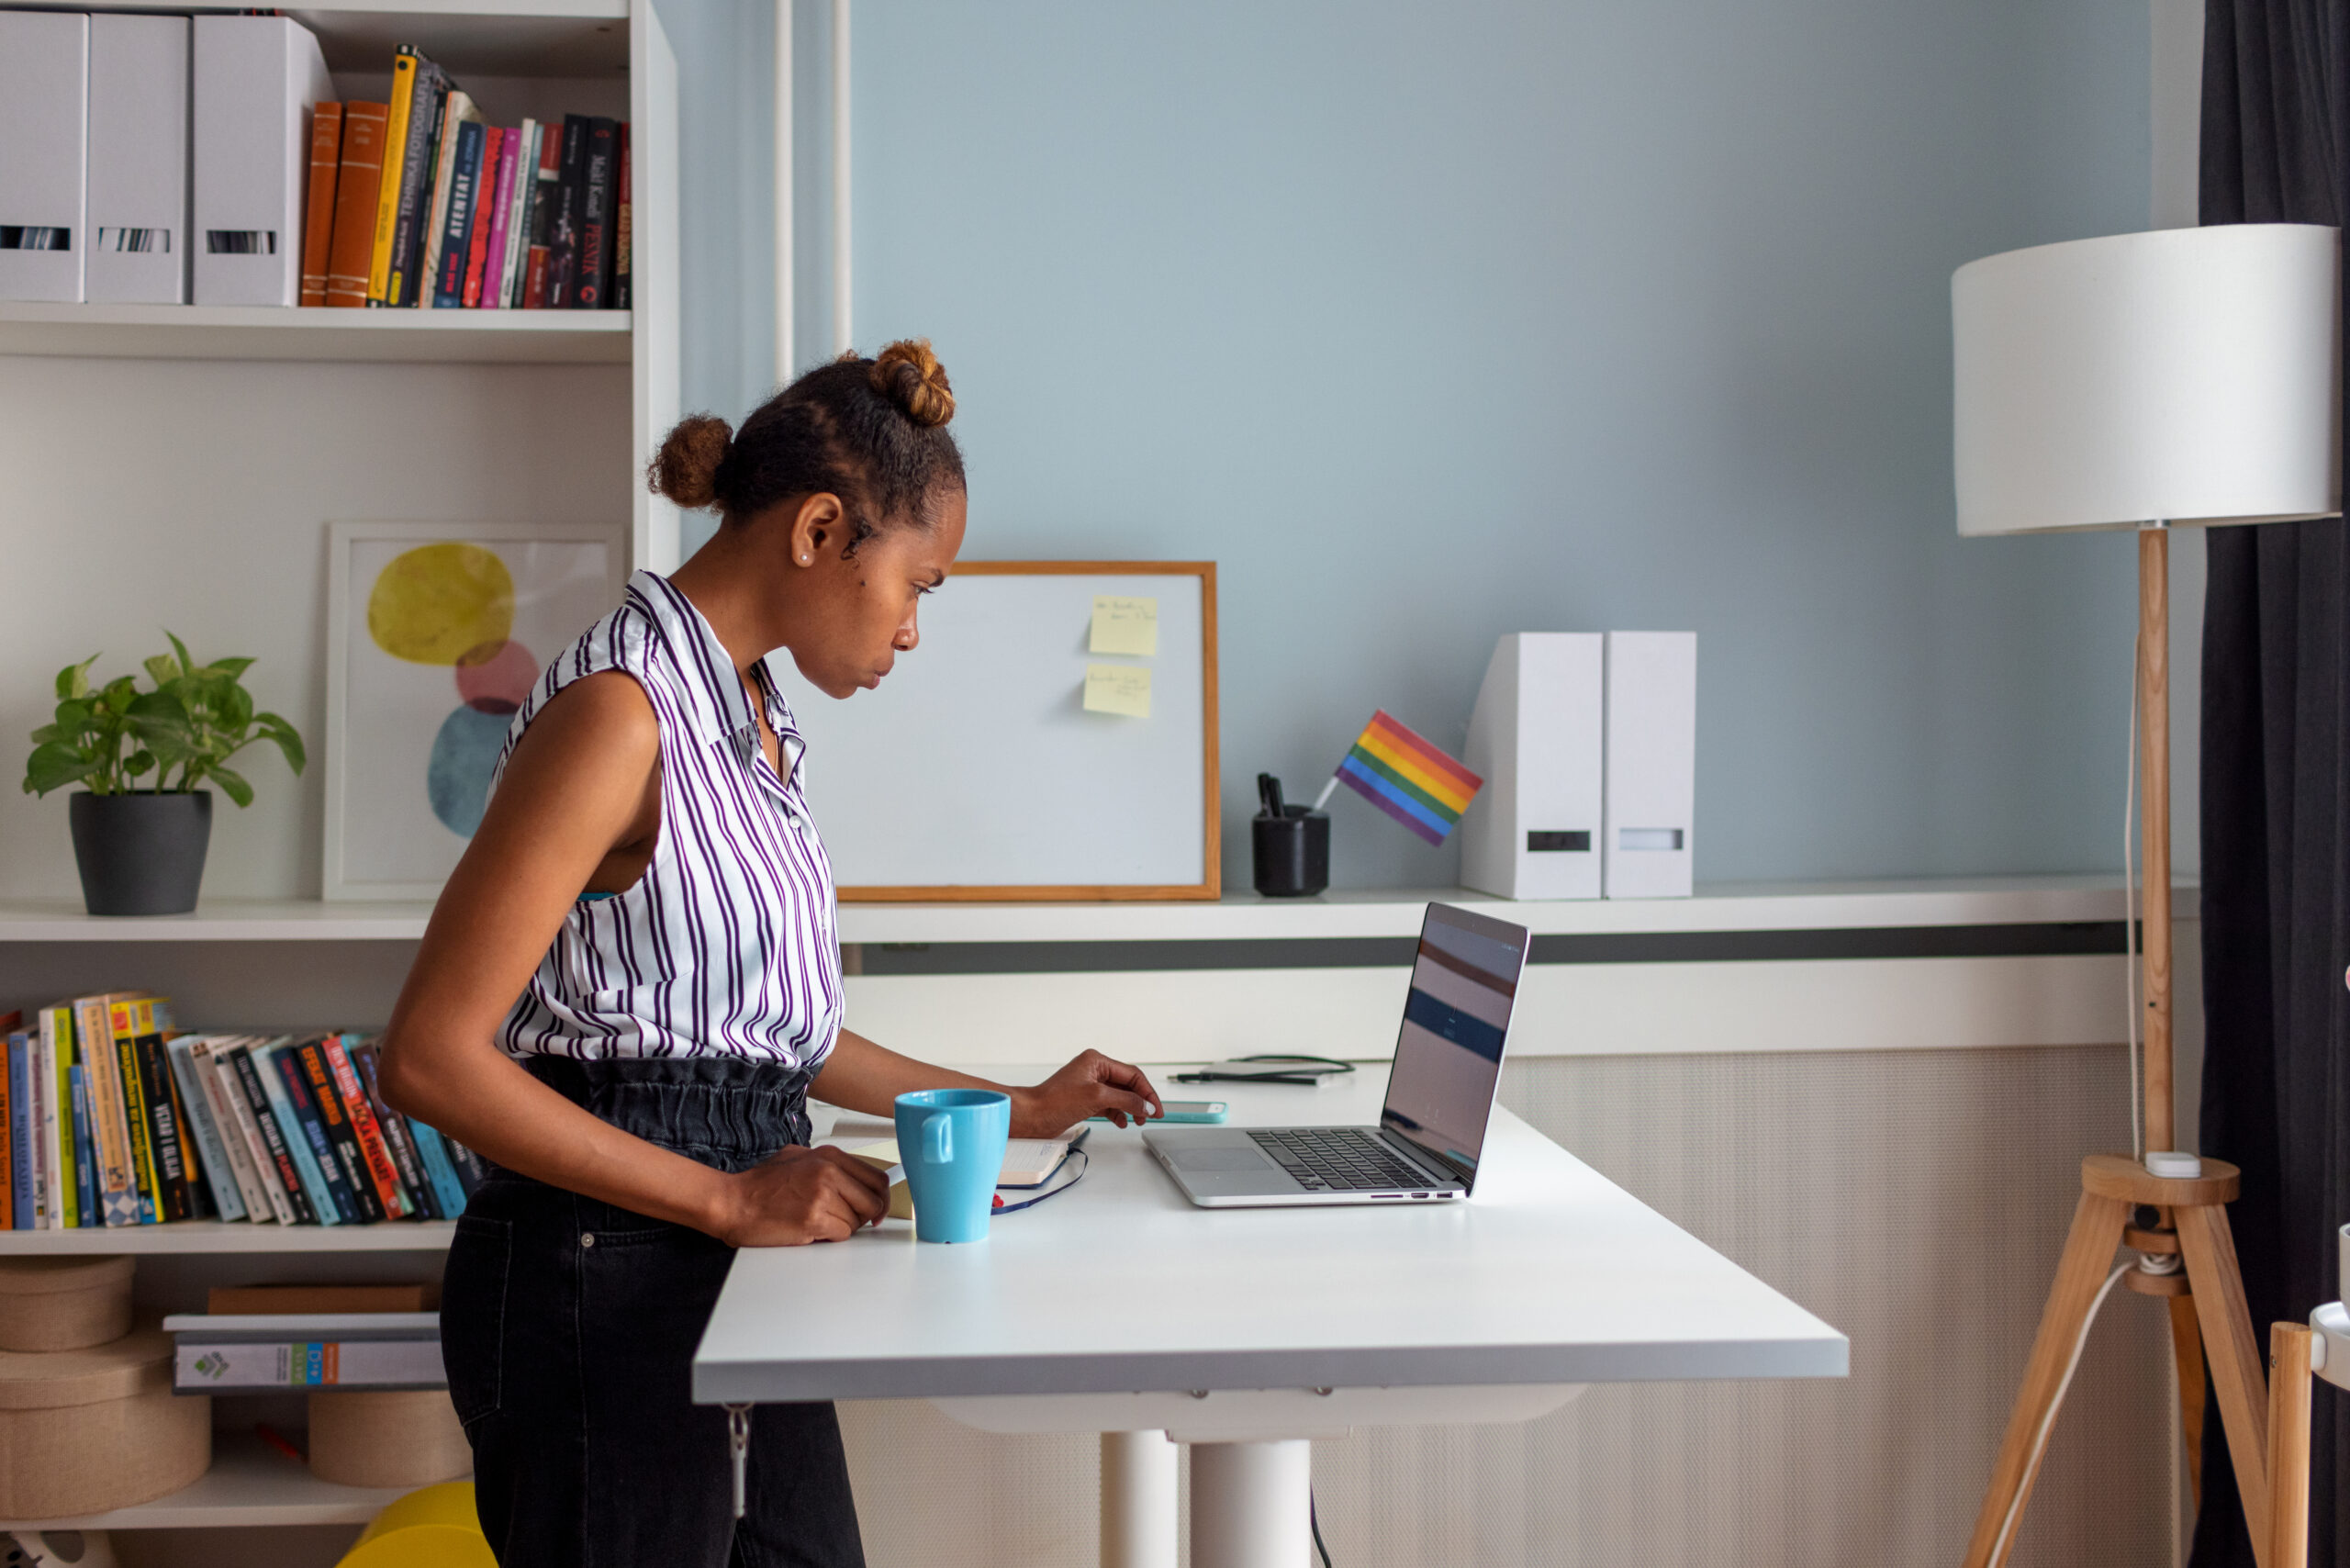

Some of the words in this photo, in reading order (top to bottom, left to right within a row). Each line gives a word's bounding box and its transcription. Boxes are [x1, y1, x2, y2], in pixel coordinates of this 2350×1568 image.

[400, 159, 418, 216] TEHNIKA
[410, 68, 431, 159] FOTOGRAFIJE
[450, 174, 471, 238] ATENTAT
[582, 224, 601, 275] PESNIK
[302, 1047, 327, 1084] EFEKAT
[17, 1114, 27, 1199] HOMEOPATIJA
[162, 1146, 181, 1179] OLUJA
[366, 1137, 389, 1181] PREVARE
